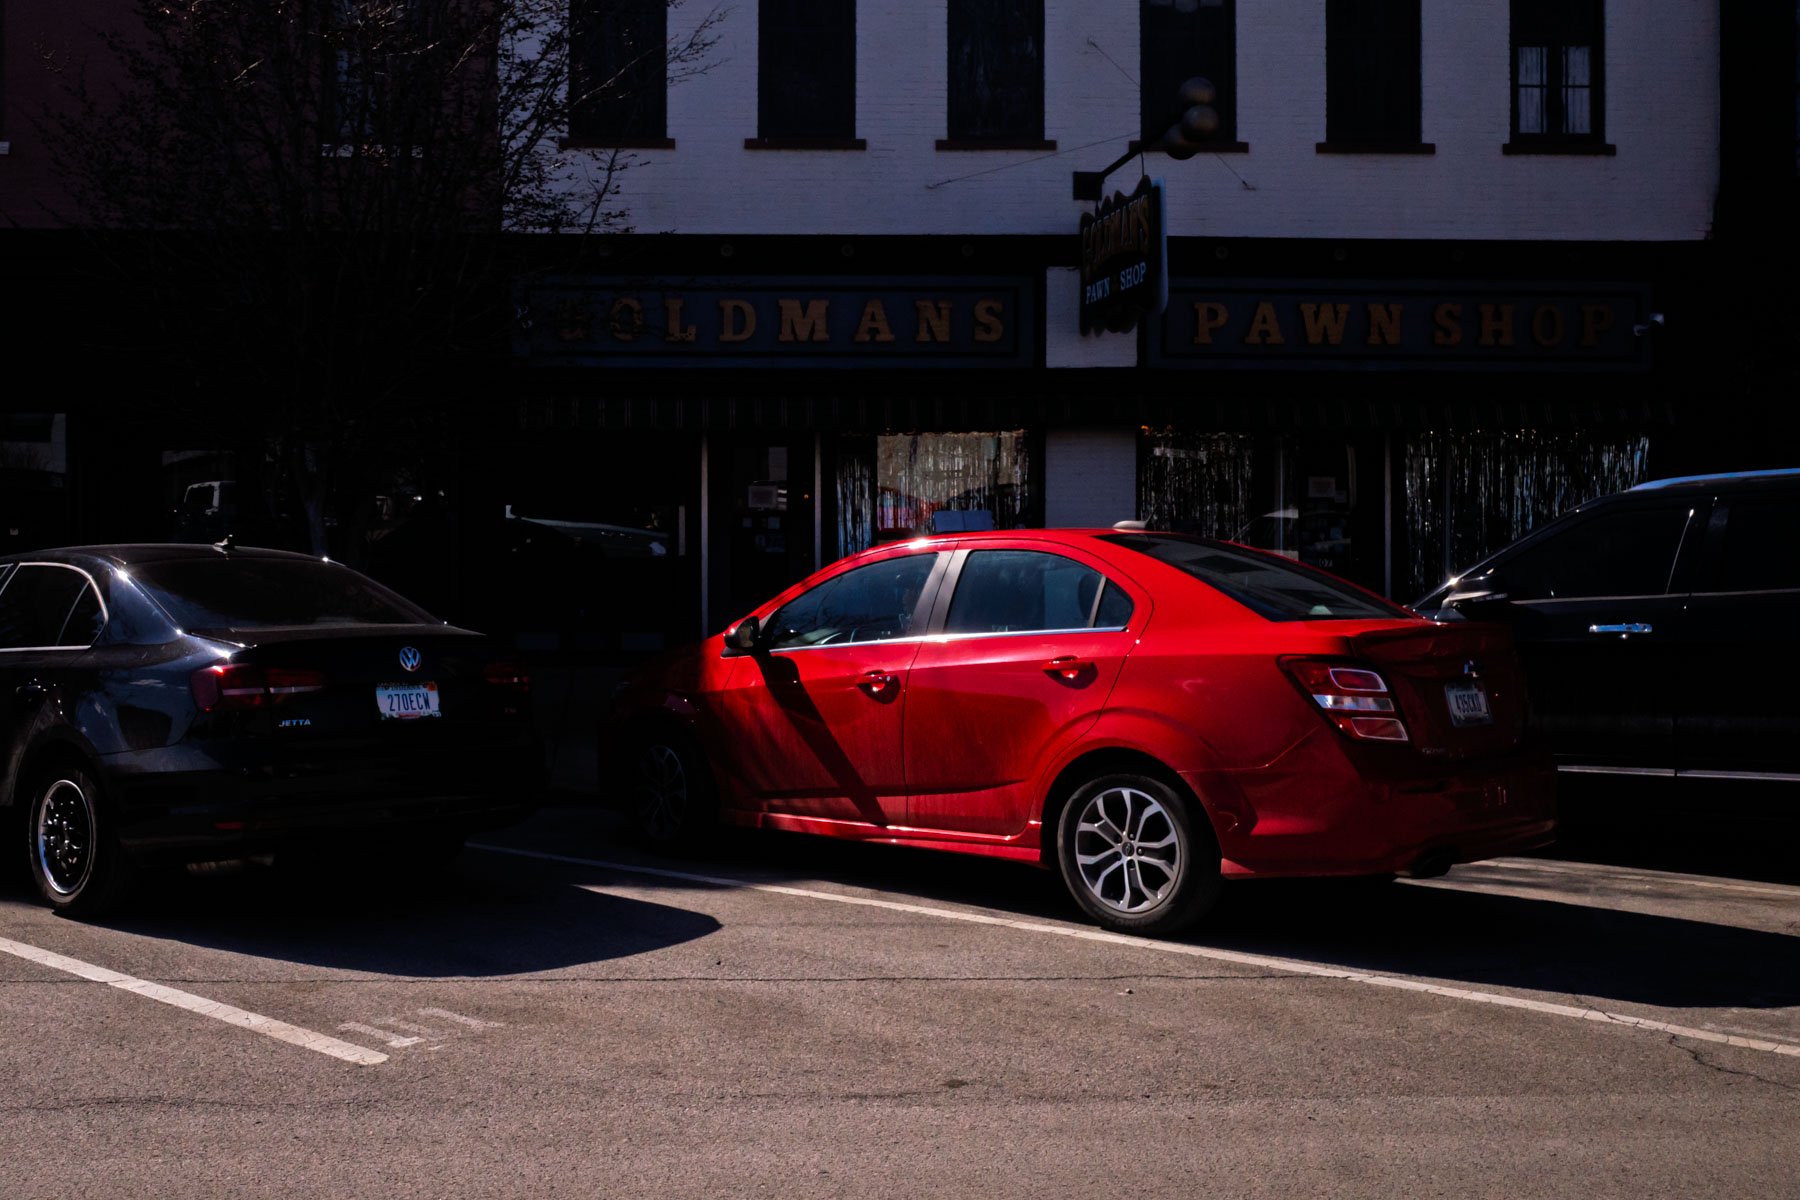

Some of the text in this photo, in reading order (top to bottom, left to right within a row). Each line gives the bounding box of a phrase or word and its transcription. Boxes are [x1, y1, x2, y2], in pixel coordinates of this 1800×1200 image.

[1085, 260, 1147, 304] PAWN SHOP
[1192, 301, 1616, 349] PAWN SHOP
[278, 719, 311, 727] JETTA
